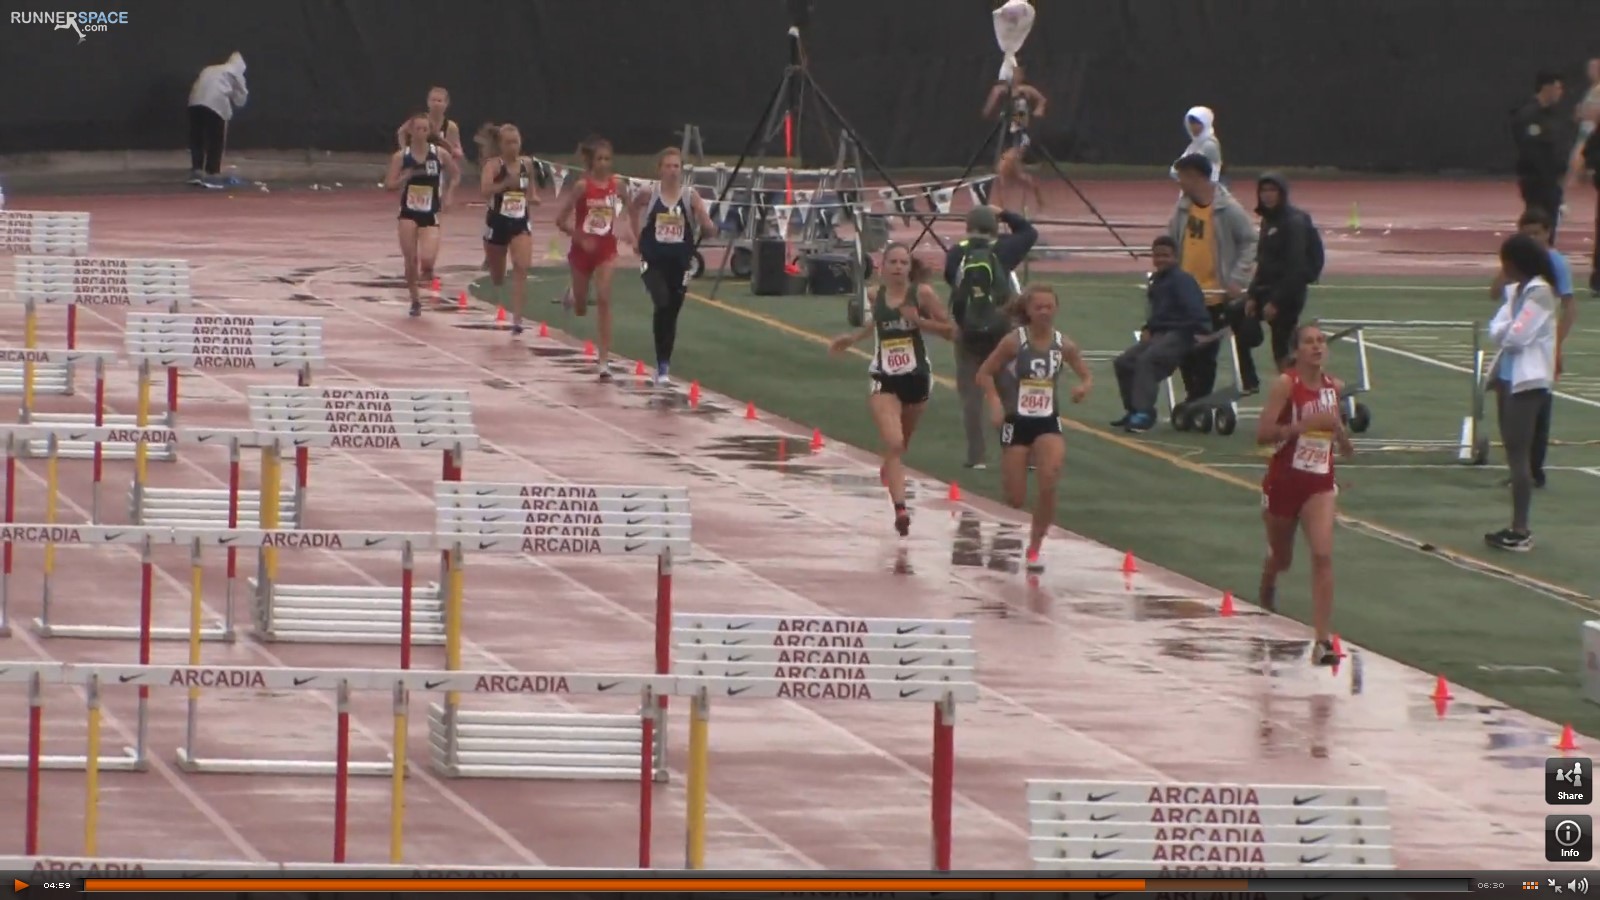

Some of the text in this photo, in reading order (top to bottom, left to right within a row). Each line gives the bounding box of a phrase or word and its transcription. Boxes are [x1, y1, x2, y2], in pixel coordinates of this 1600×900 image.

[193, 356, 256, 368] ARCADIA
[888, 354, 909, 368] 600
[1021, 394, 1050, 410] 2847
[107, 429, 178, 443] ARCADIA
[330, 436, 402, 448] ARCADIA
[520, 486, 597, 498] ARCADIA
[521, 500, 599, 511] ARCADIA
[526, 513, 604, 524] ARCADIA
[0, 527, 81, 542] ARCADIA
[523, 526, 601, 536] ARCADIA
[261, 533, 342, 547] ARCADIA
[521, 538, 602, 553] ARCADIA
[778, 619, 868, 633] ARCADIA
[773, 635, 864, 648] ARCADIA
[778, 650, 870, 664] ARCADIA
[169, 669, 266, 688] ARCADIA
[774, 667, 866, 679] ARCADIA
[475, 675, 570, 693] ARCADIA
[777, 682, 872, 699] ARCADIA
[1148, 787, 1259, 805] ARCADIA
[1150, 808, 1261, 824] ARCADIA
[1154, 828, 1265, 842] ARCADIA
[1152, 845, 1265, 862] ARCADIA
